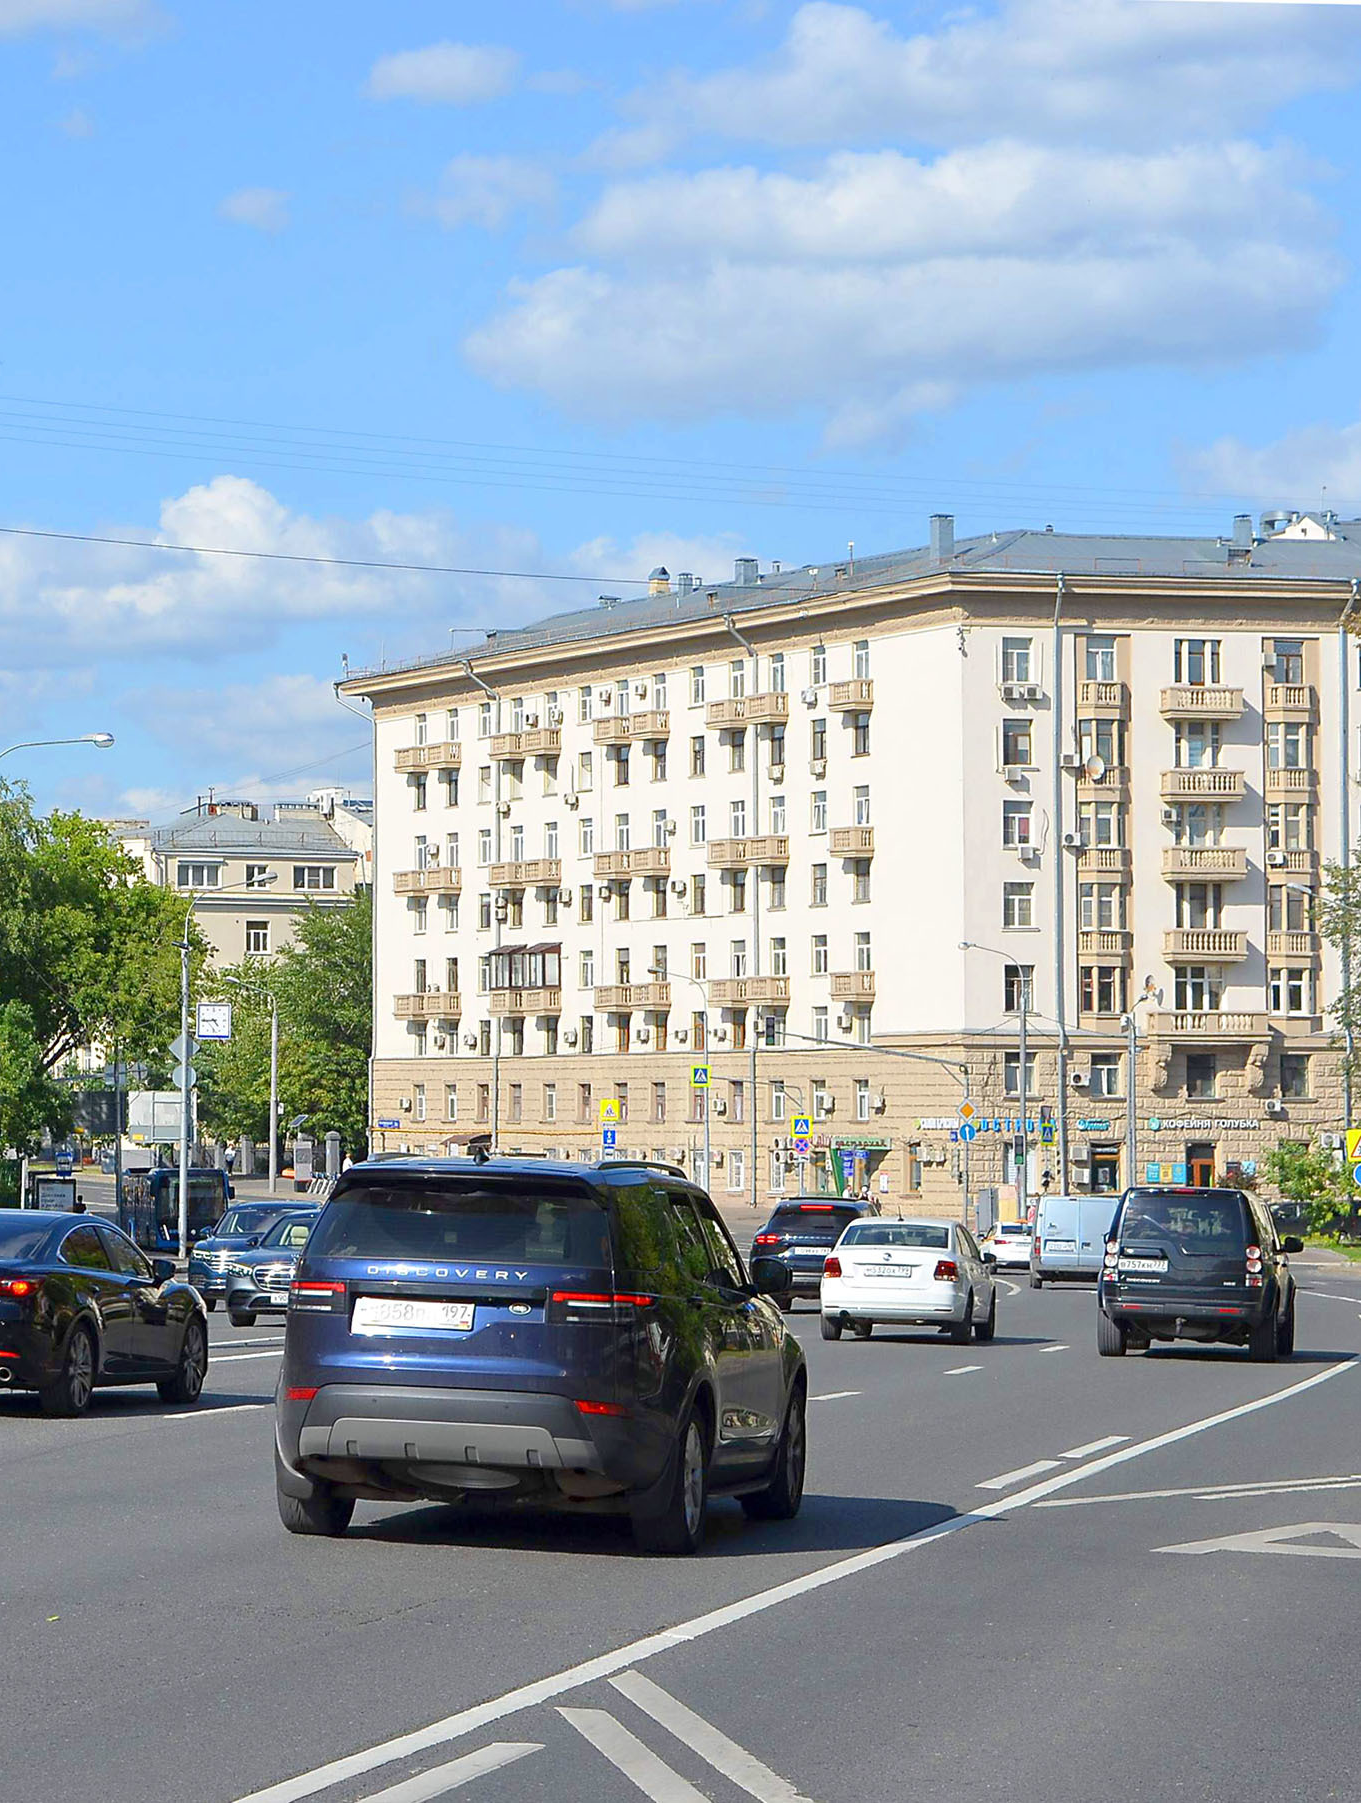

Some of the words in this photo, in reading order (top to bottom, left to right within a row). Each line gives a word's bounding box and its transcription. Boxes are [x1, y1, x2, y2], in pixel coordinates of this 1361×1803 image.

[1162, 1118, 1211, 1129] КОФЕЙНЯ
[1214, 1118, 1259, 1129] ГОЛУБКА
[367, 1264, 528, 1281] DISCOVERY
